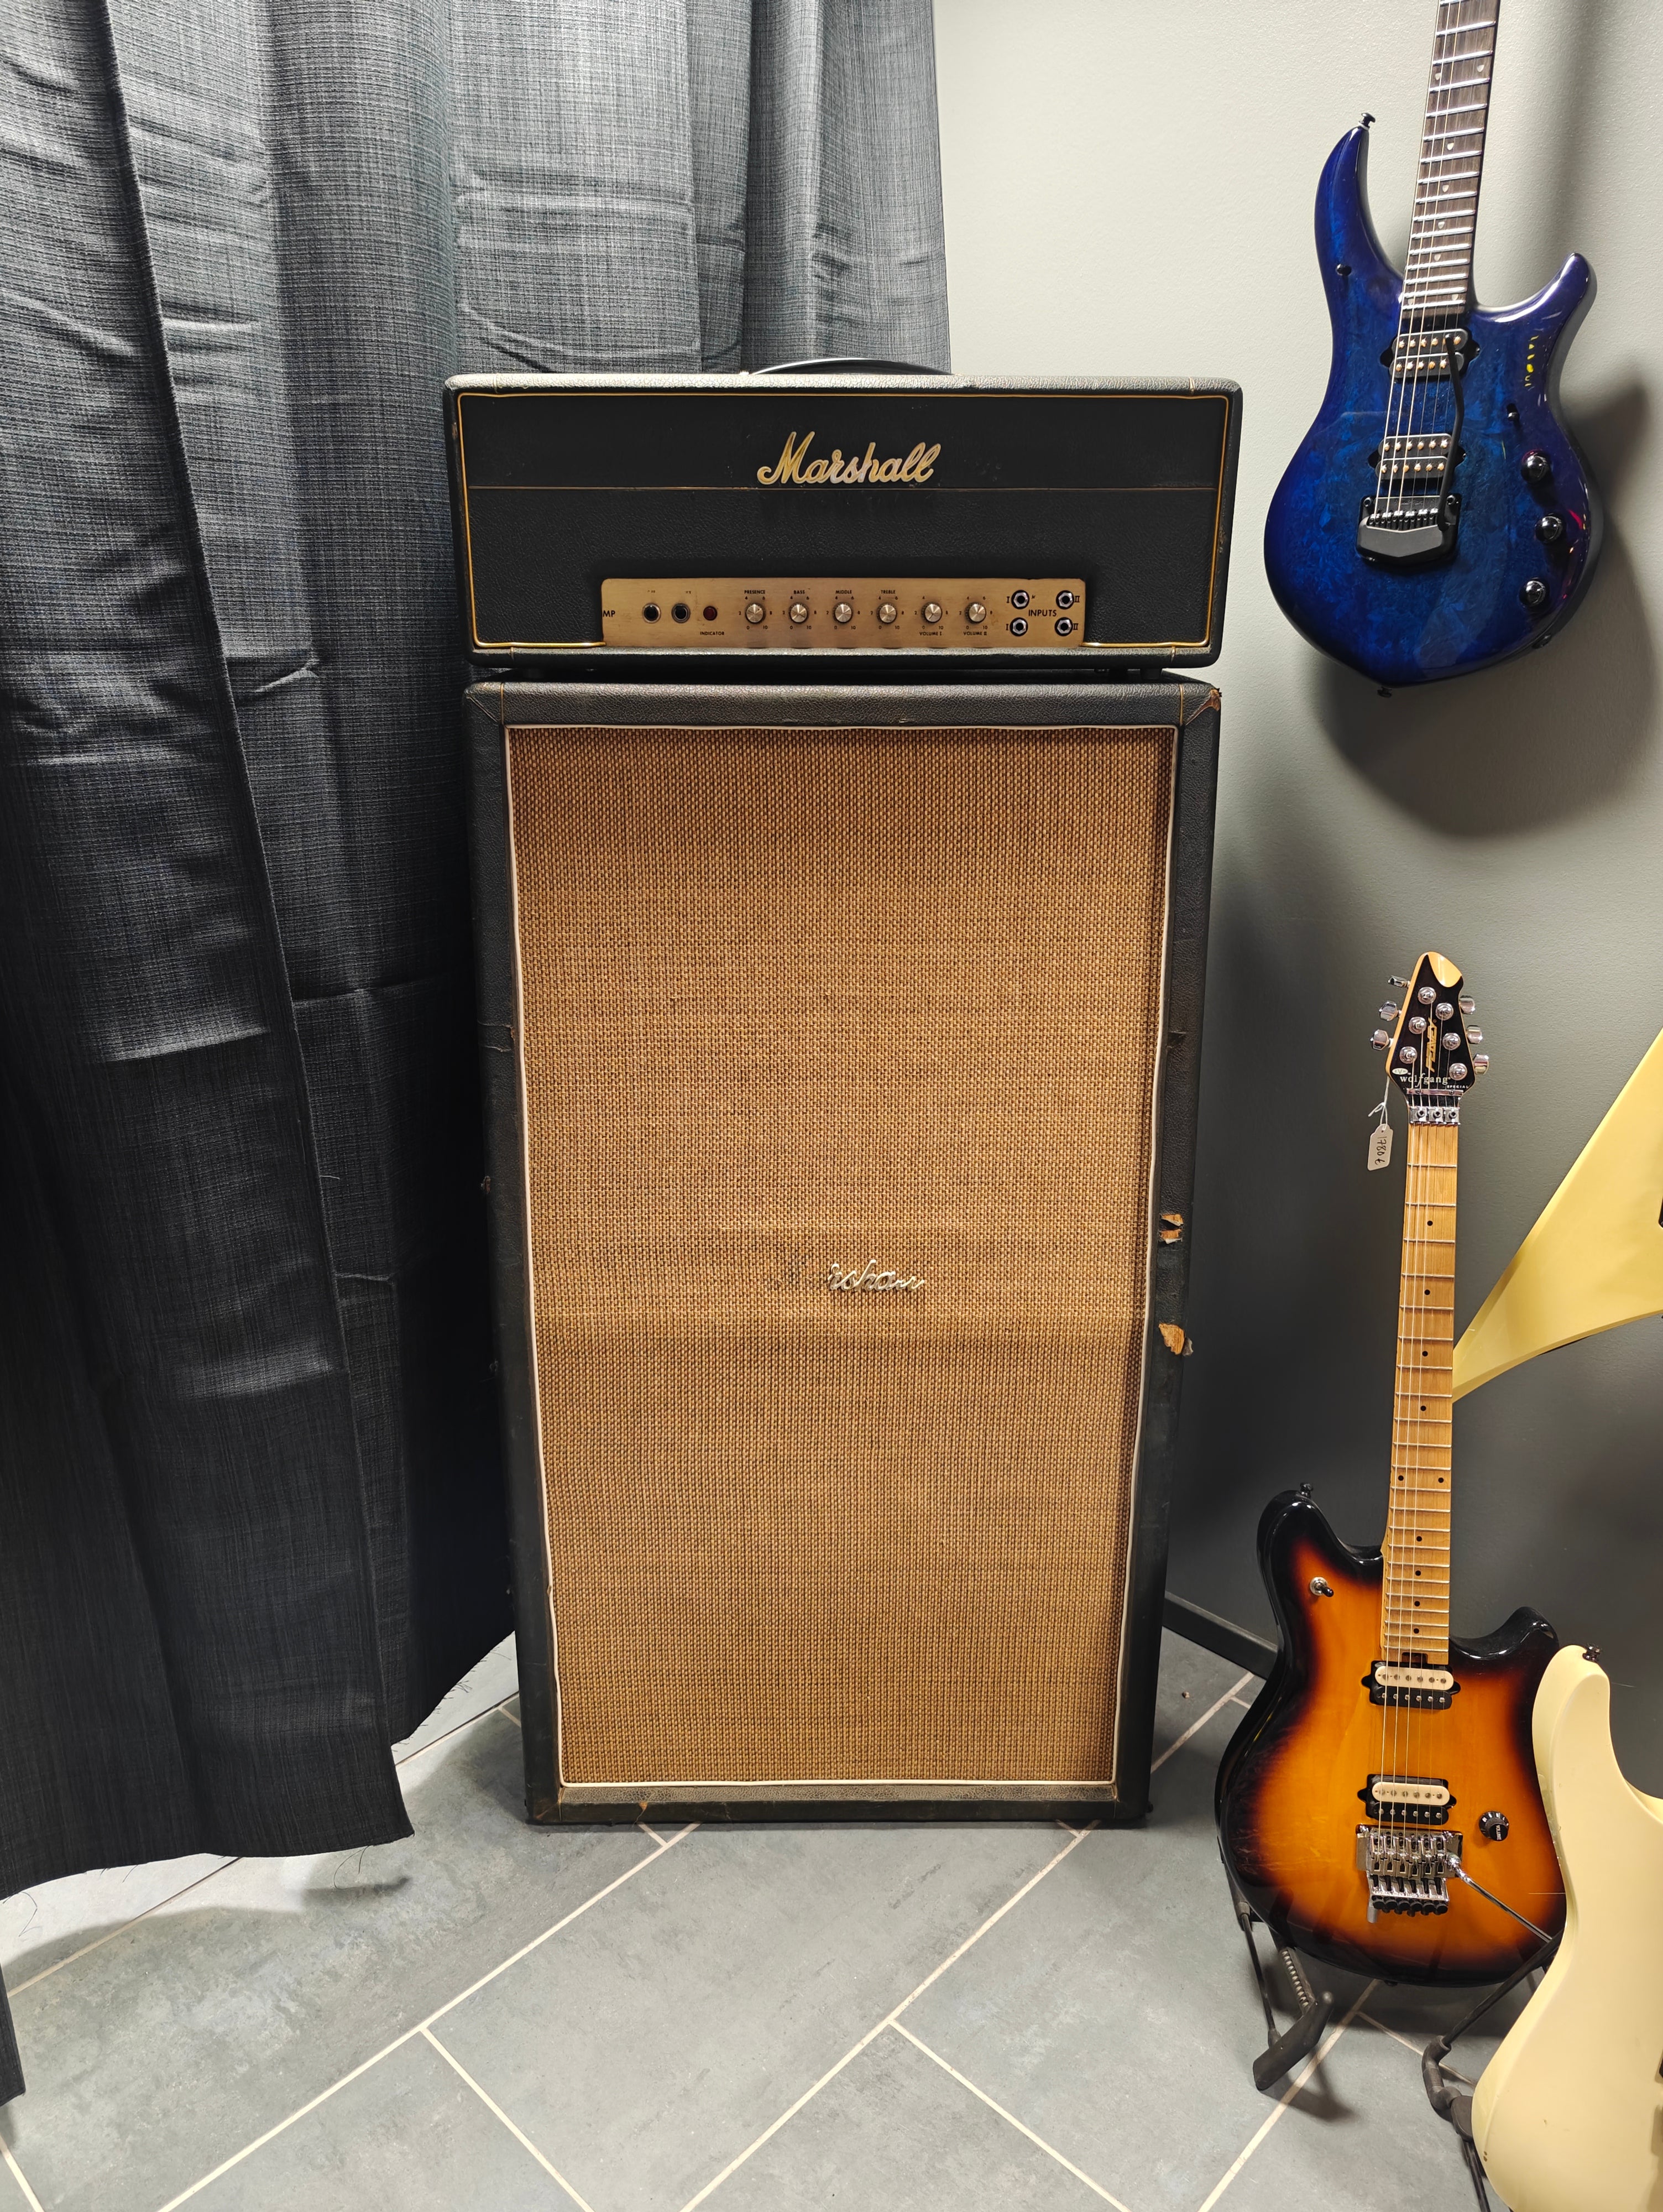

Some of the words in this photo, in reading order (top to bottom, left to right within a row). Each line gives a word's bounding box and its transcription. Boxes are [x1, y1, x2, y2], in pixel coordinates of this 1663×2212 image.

[757, 431, 941, 485] Marshall
[1425, 1017, 1437, 1073] PEAVEY
[1399, 1073, 1448, 1087] wolfgang
